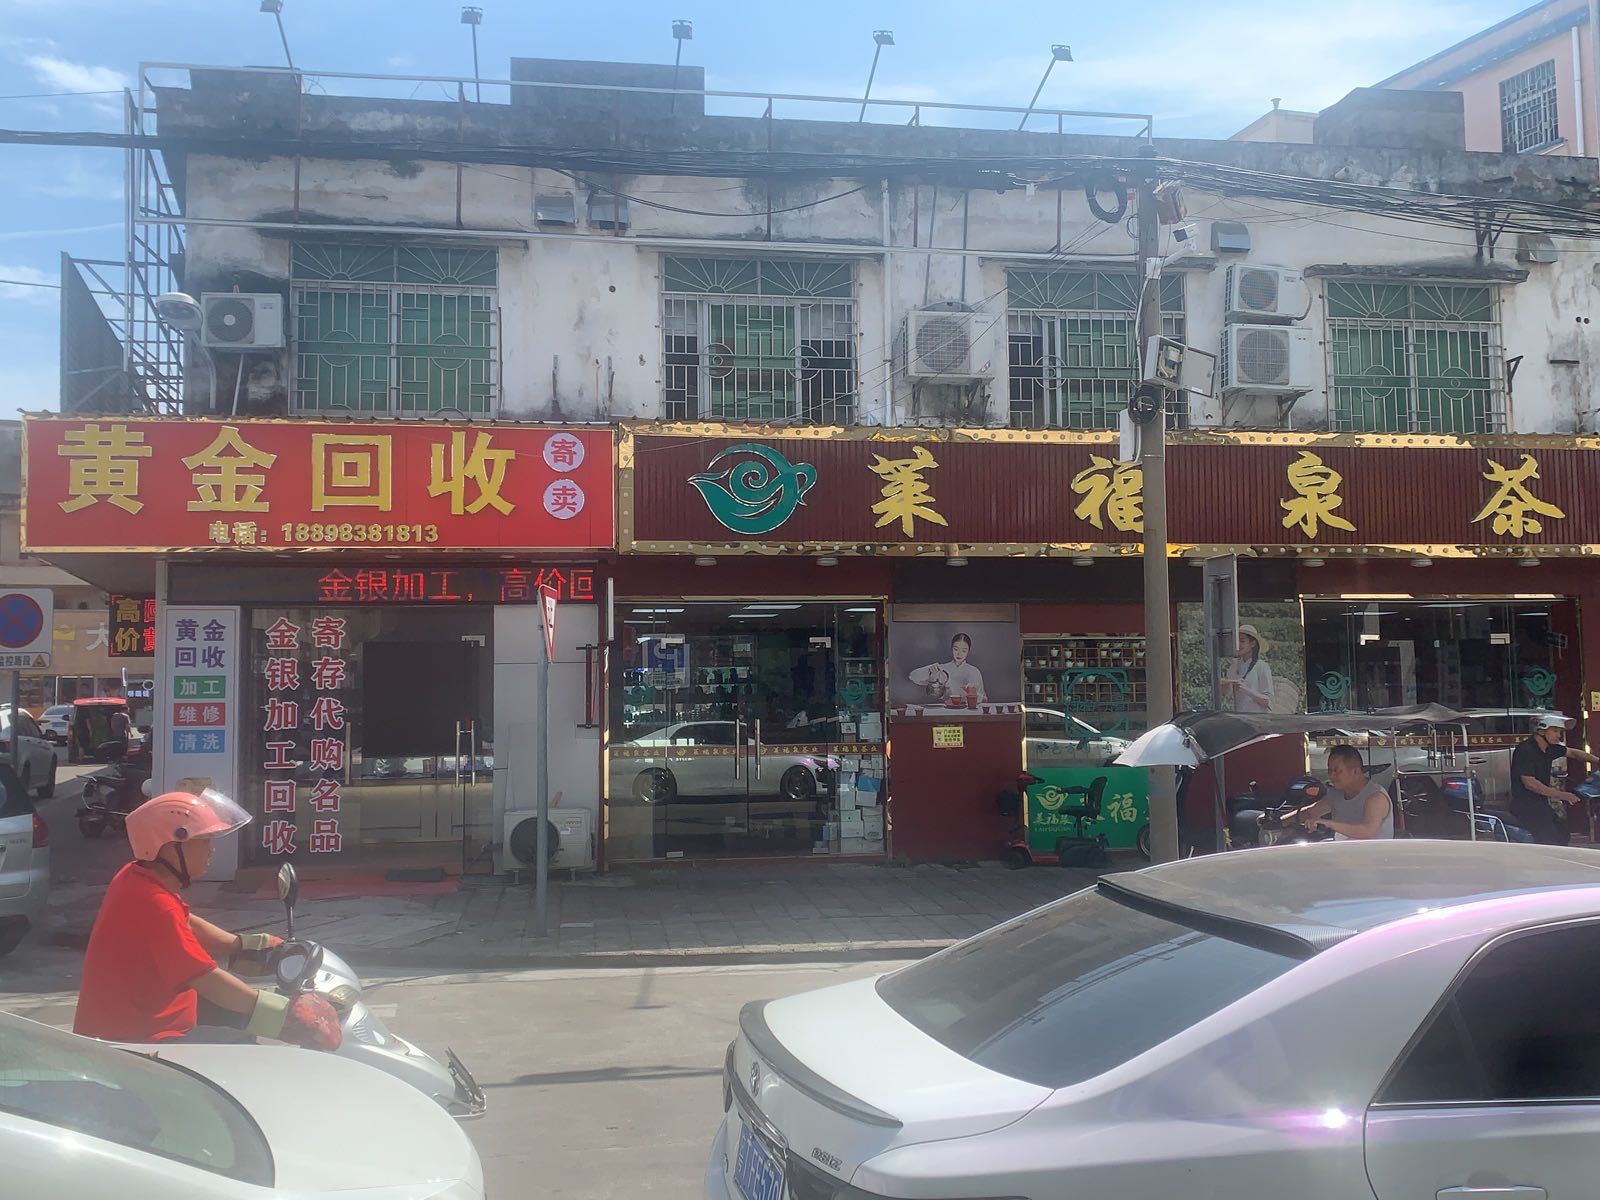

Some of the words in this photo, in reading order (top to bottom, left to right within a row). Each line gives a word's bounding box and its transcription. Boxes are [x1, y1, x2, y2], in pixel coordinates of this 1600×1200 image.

[57, 423, 516, 516] 黄金回收
[549, 438, 578, 513] 寄卖
[115, 598, 141, 652] 高价
[175, 618, 227, 642] 黄金
[175, 646, 226, 668] 回收
[179, 679, 221, 696] 加工
[179, 704, 221, 724] 维修
[178, 732, 220, 750] 清洗
[263, 616, 300, 854] 金银加工回收
[310, 616, 347, 853] 寄存代购名品
